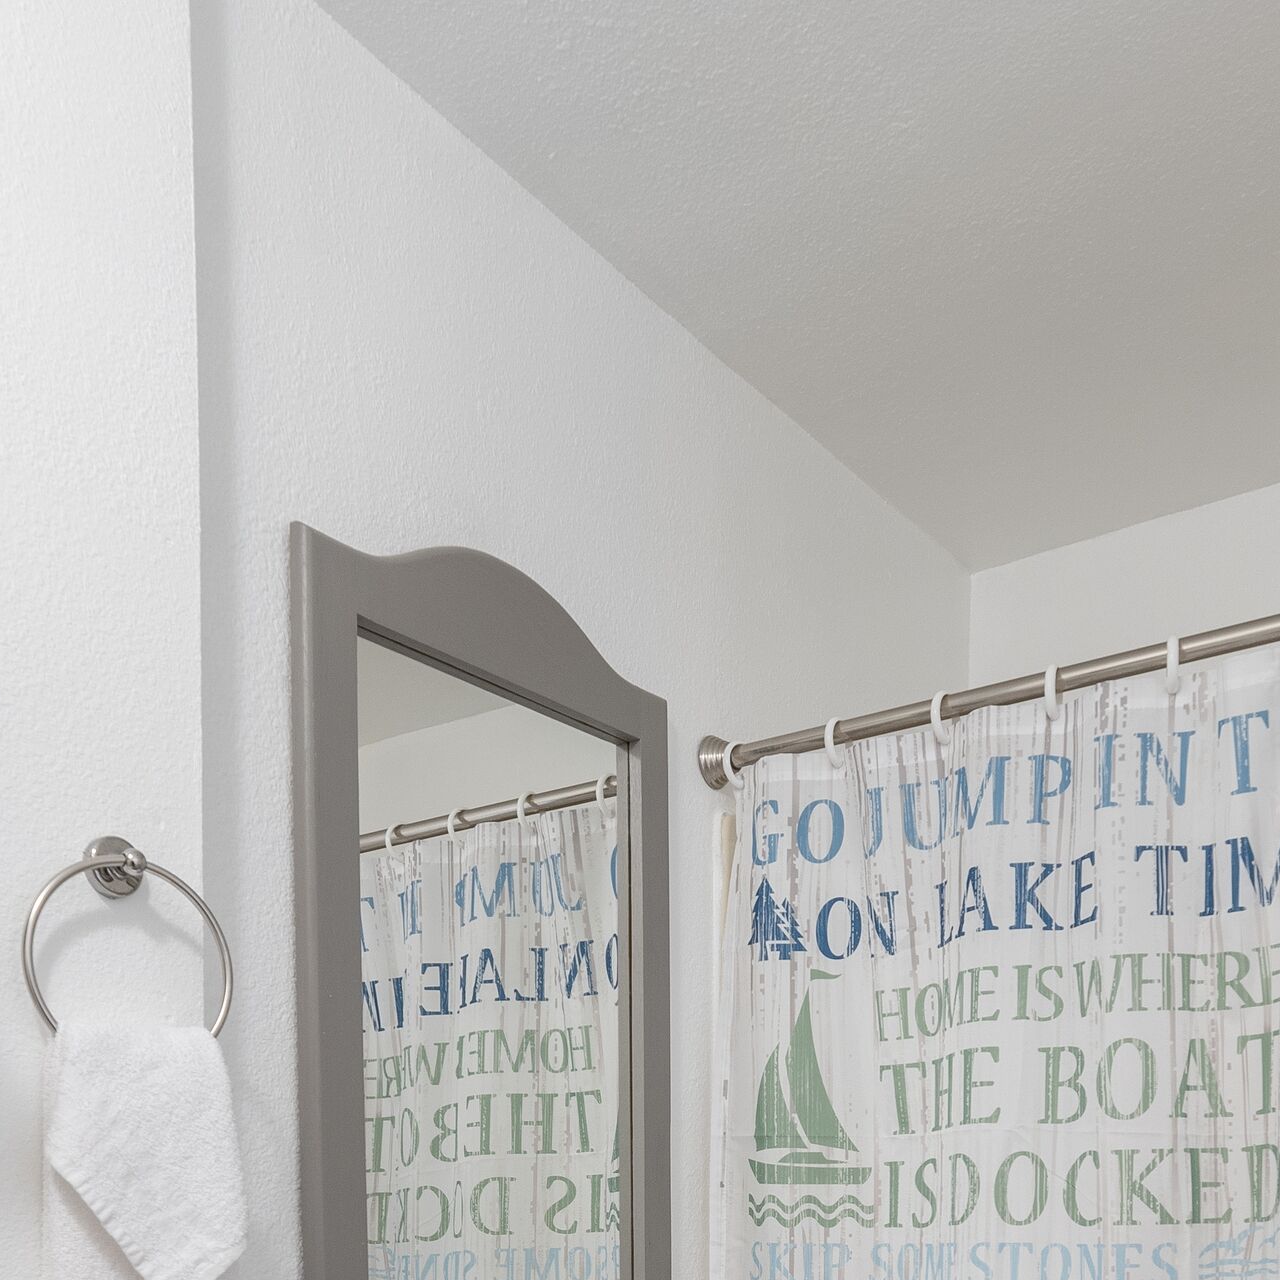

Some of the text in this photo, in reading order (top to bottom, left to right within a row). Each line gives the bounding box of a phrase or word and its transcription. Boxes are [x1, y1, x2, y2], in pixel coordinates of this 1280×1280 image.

[751, 799, 844, 866] GO
[864, 754, 1072, 858] JUMP
[1094, 730, 1195, 810] IN
[815, 890, 898, 960] ON
[936, 850, 1098, 949] LAKE
[875, 965, 1001, 1042] HOME
[1012, 963, 1064, 1022] IS
[879, 1045, 1002, 1135] THE
